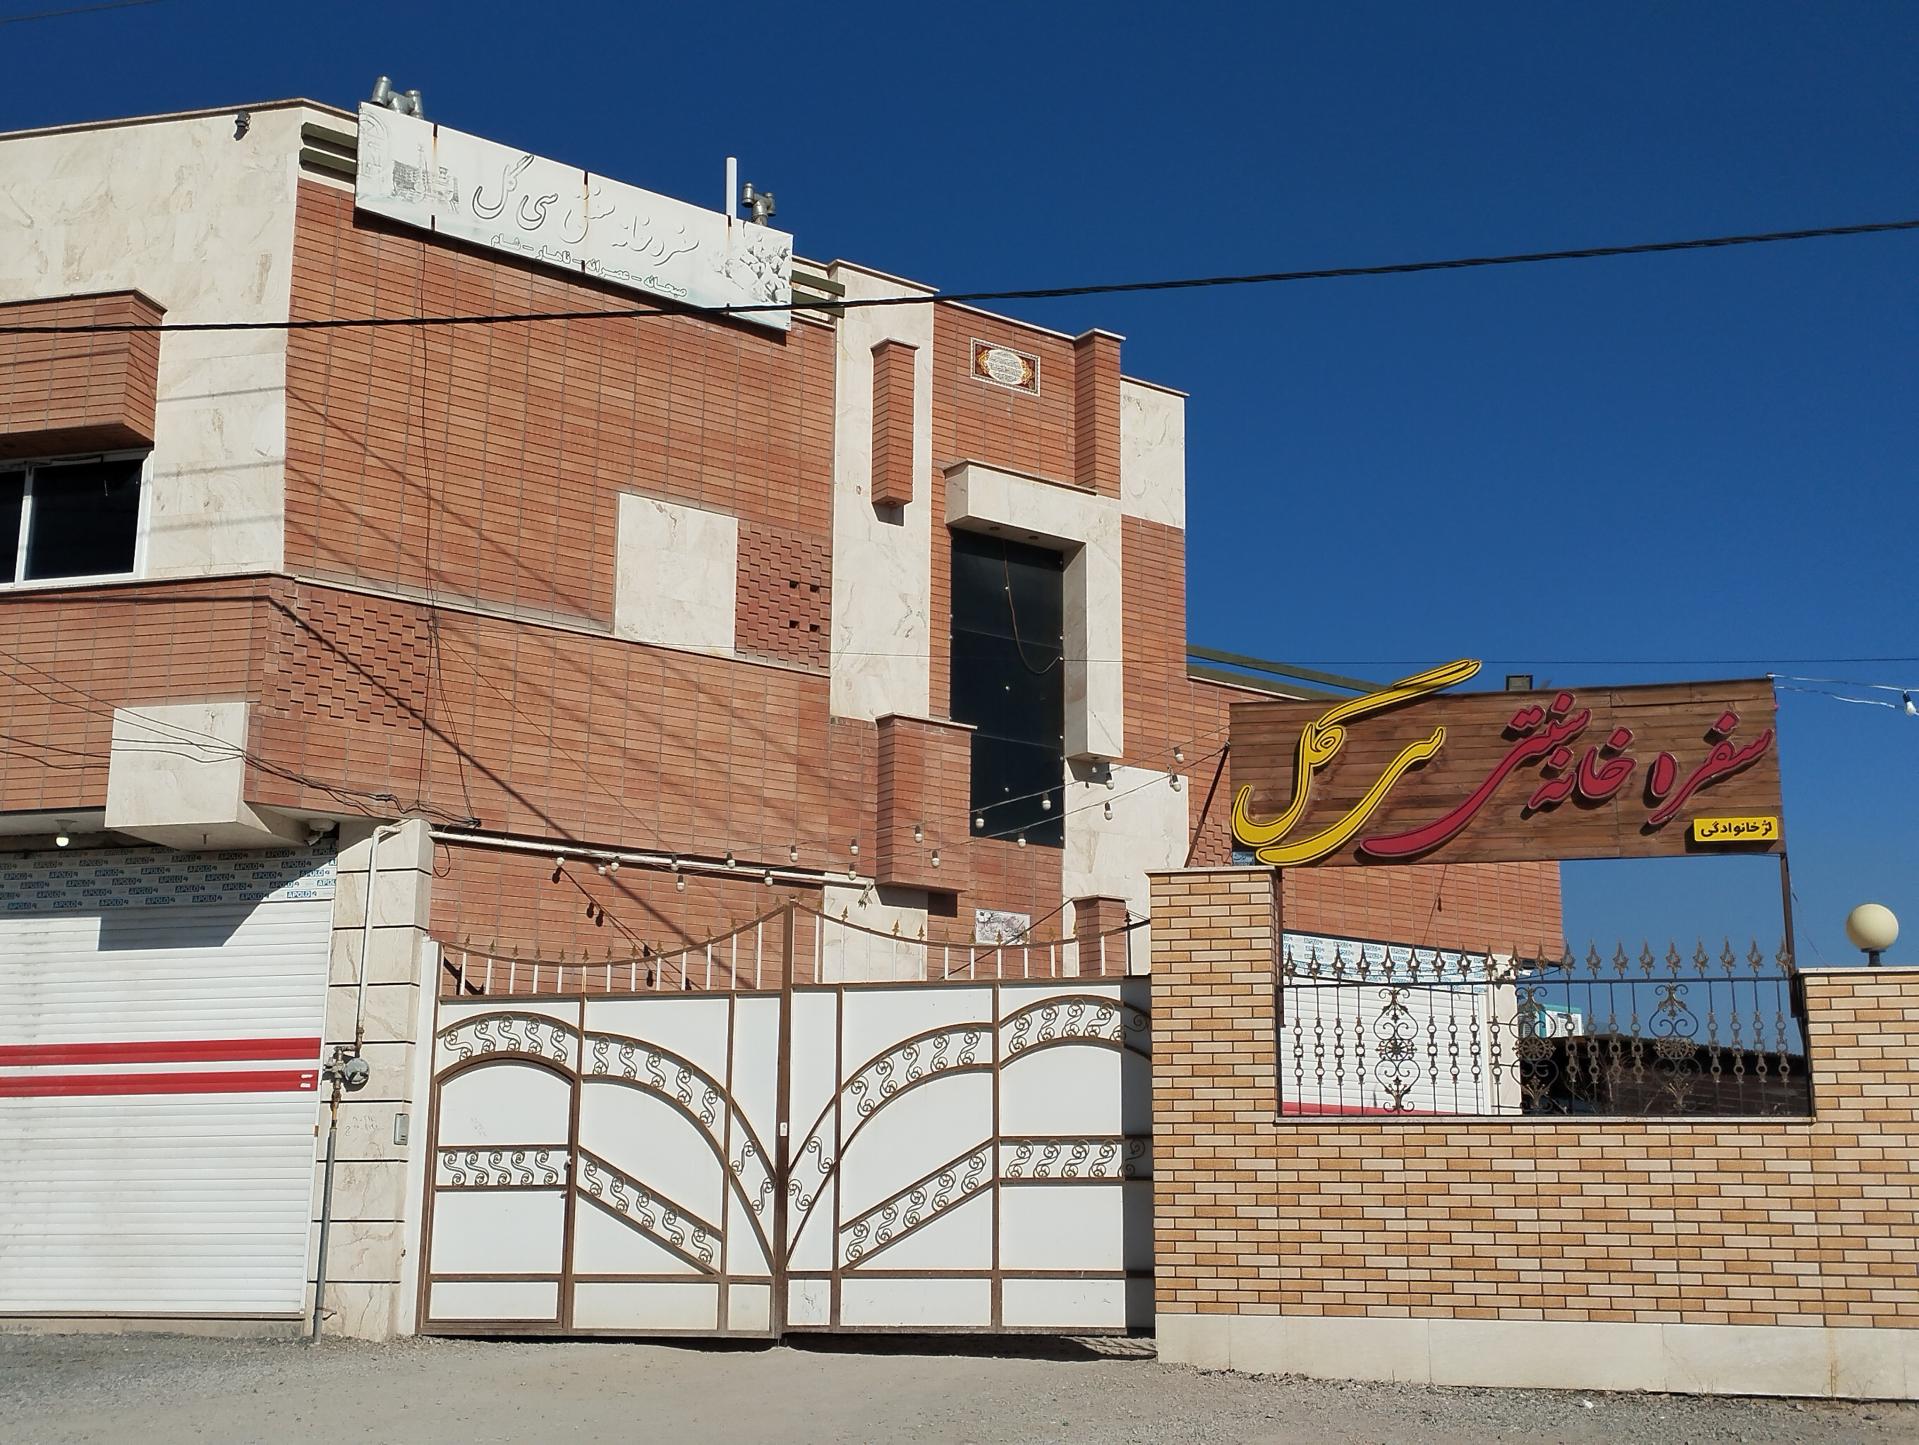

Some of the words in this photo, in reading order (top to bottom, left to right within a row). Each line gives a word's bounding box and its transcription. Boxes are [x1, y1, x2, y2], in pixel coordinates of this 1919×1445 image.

[472, 154, 535, 220] گل
[516, 193, 559, 231] سی
[535, 244, 571, 264] ناهار
[585, 258, 630, 281] عصرانه
[643, 274, 687, 298] صبحانه
[1231, 659, 1482, 847] گل
[1360, 691, 1592, 858] سنتی
[1528, 726, 1637, 810] خانه
[1700, 820, 1760, 838] خانوادگی
[1761, 819, 1773, 836] لژ
[145, 896, 169, 904] APOLO
